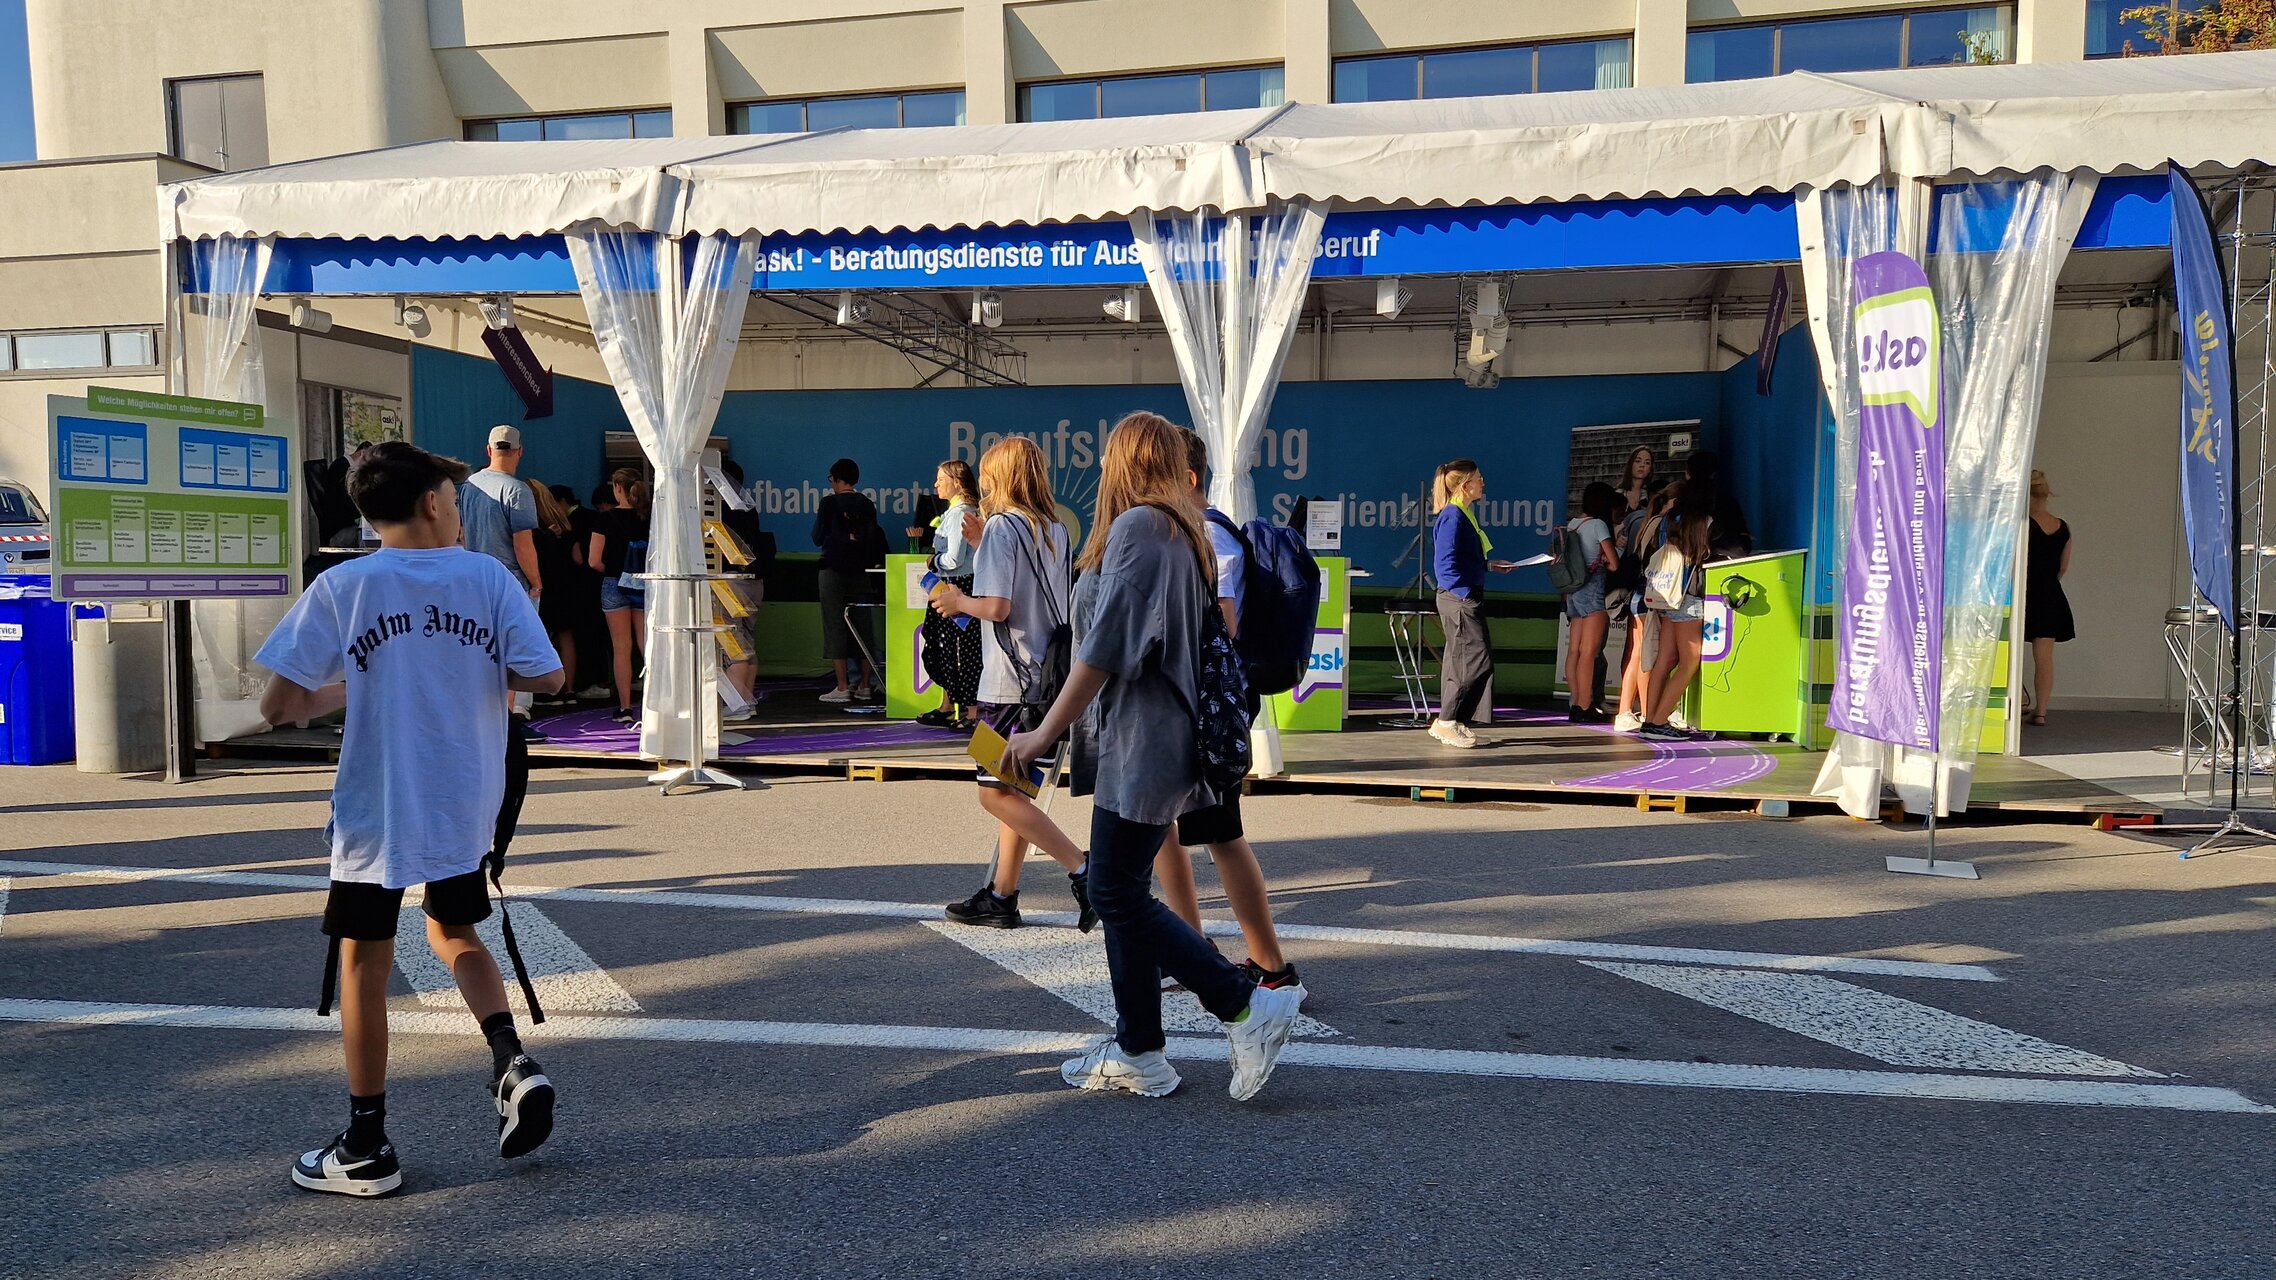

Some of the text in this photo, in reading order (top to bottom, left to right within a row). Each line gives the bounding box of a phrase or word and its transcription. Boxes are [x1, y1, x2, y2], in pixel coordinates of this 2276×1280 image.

[754, 247, 803, 272] ask!
[830, 241, 1043, 275] Beratungsdienste
[1051, 240, 1087, 267] für
[497, 329, 541, 397] Interessencheck
[97, 394, 125, 406] Welche
[127, 397, 177, 412] Möglichkeiten
[179, 404, 203, 413] stehen
[204, 407, 216, 415] mir
[217, 408, 239, 417] offen?
[1671, 438, 1689, 447] ask!
[0, 626, 17, 635] vice
